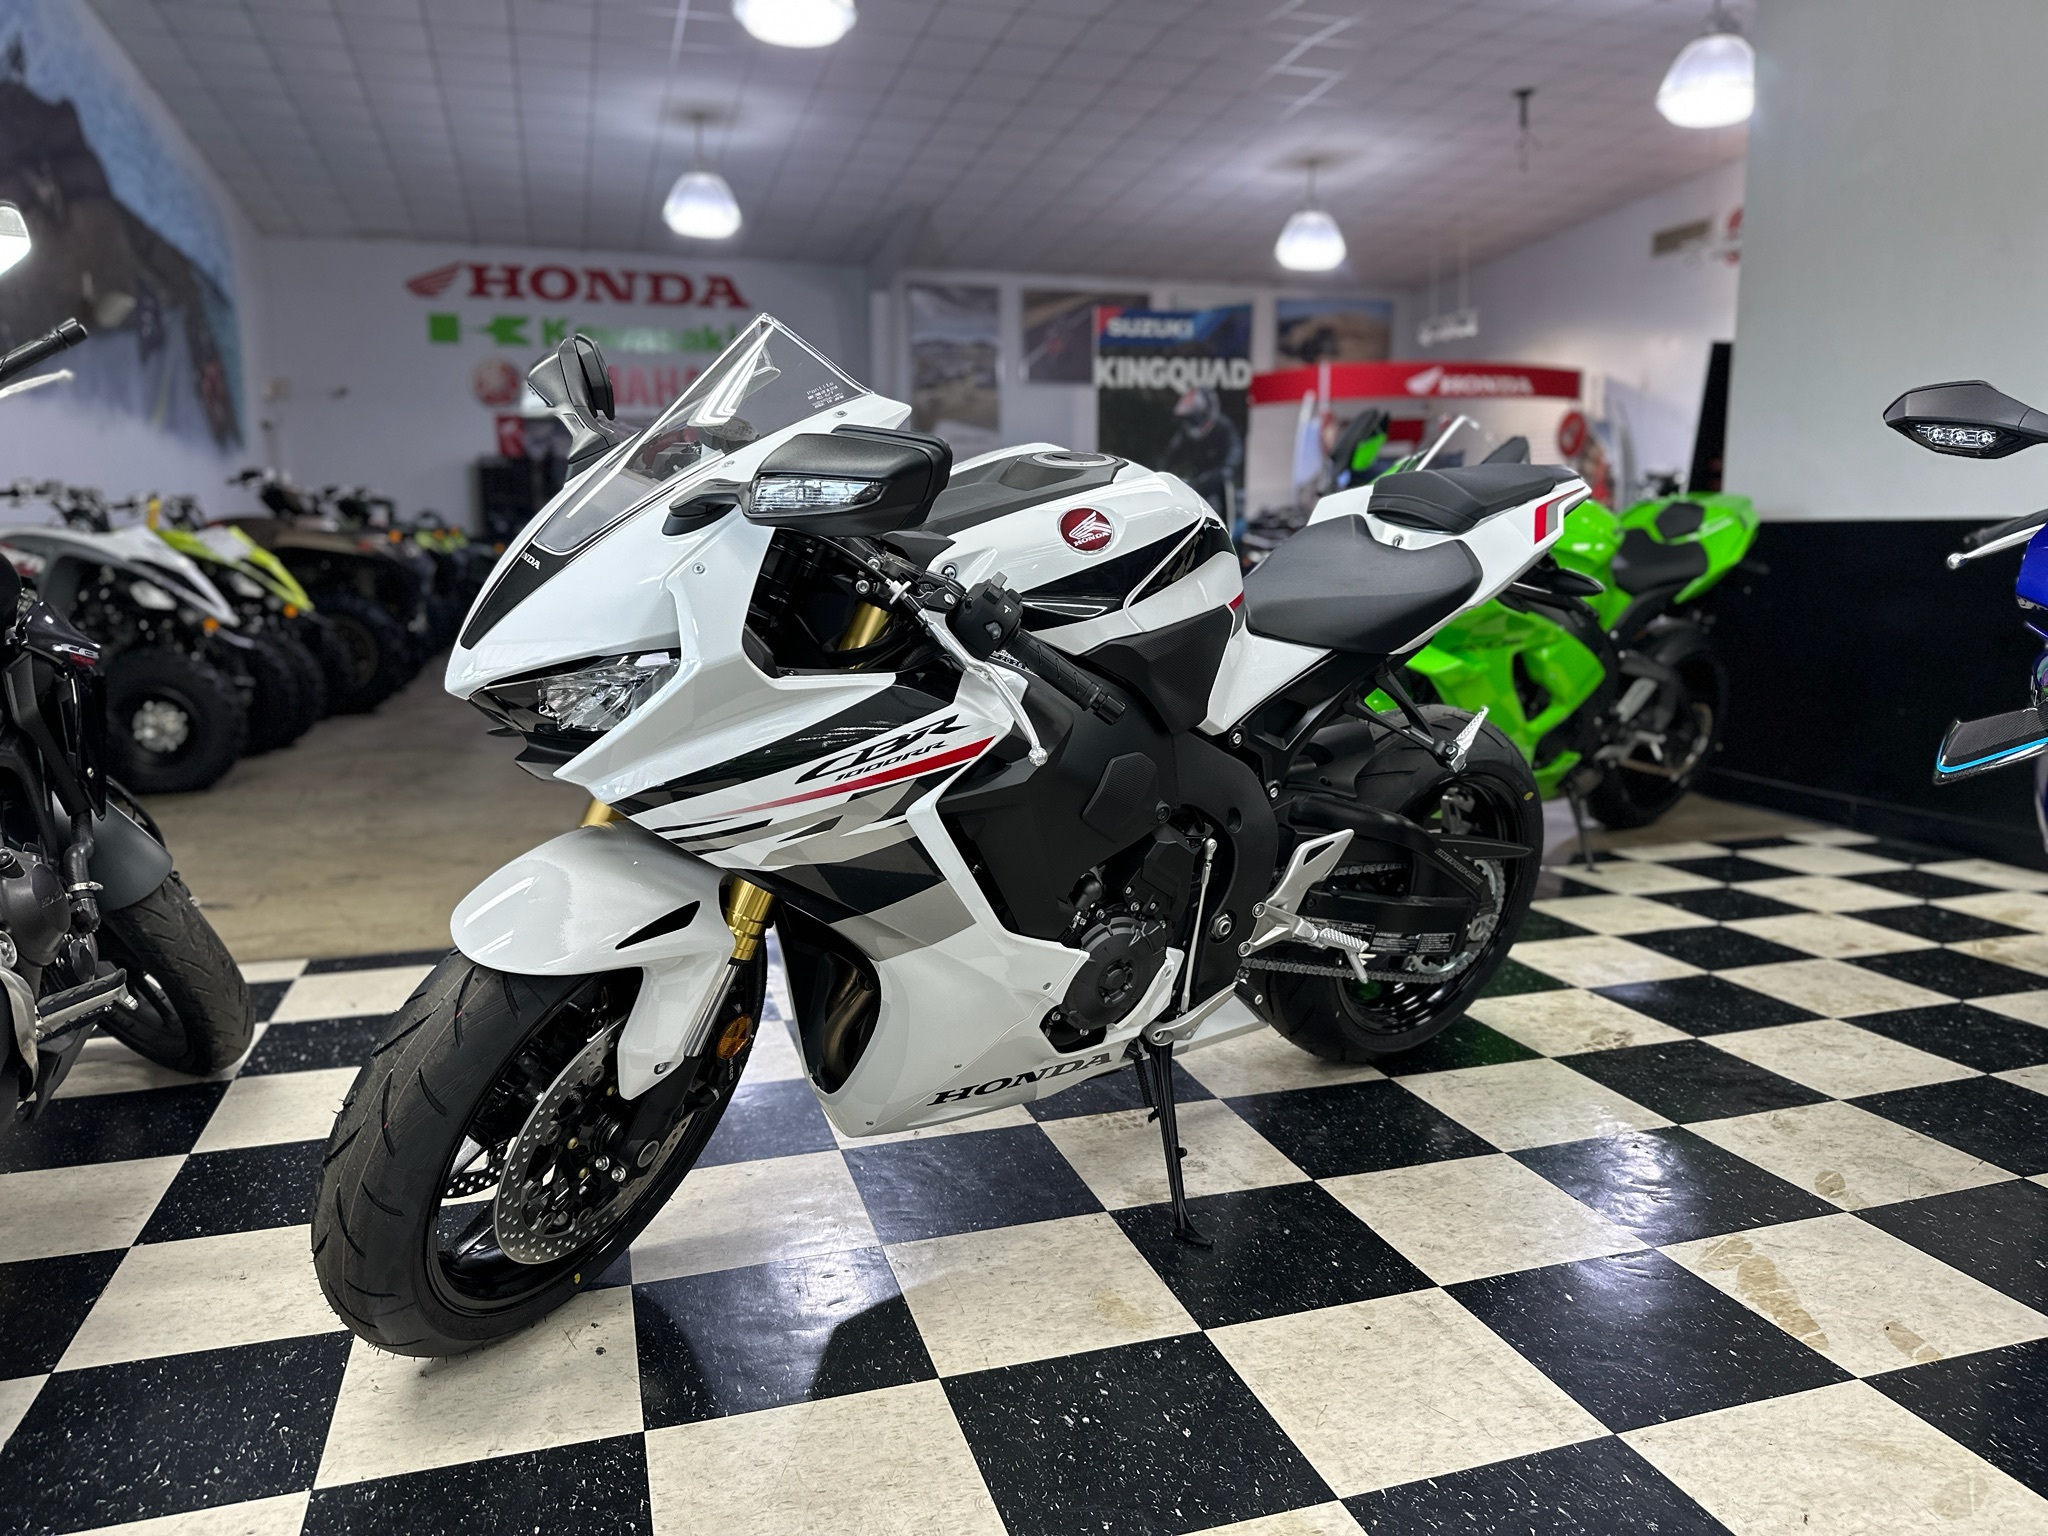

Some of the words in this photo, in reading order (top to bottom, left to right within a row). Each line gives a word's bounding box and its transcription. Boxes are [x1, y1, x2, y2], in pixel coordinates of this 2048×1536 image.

[466, 262, 751, 309] HONDA
[1106, 316, 1194, 338] SUZUKI
[1094, 356, 1252, 394] KINGQUAD
[1438, 373, 1535, 396] HONDA
[1072, 531, 1110, 547] HONDA
[521, 552, 541, 570] NDA
[794, 713, 971, 784] CBR
[834, 739, 947, 782] 1000RR
[926, 1052, 1112, 1106] HONDA
